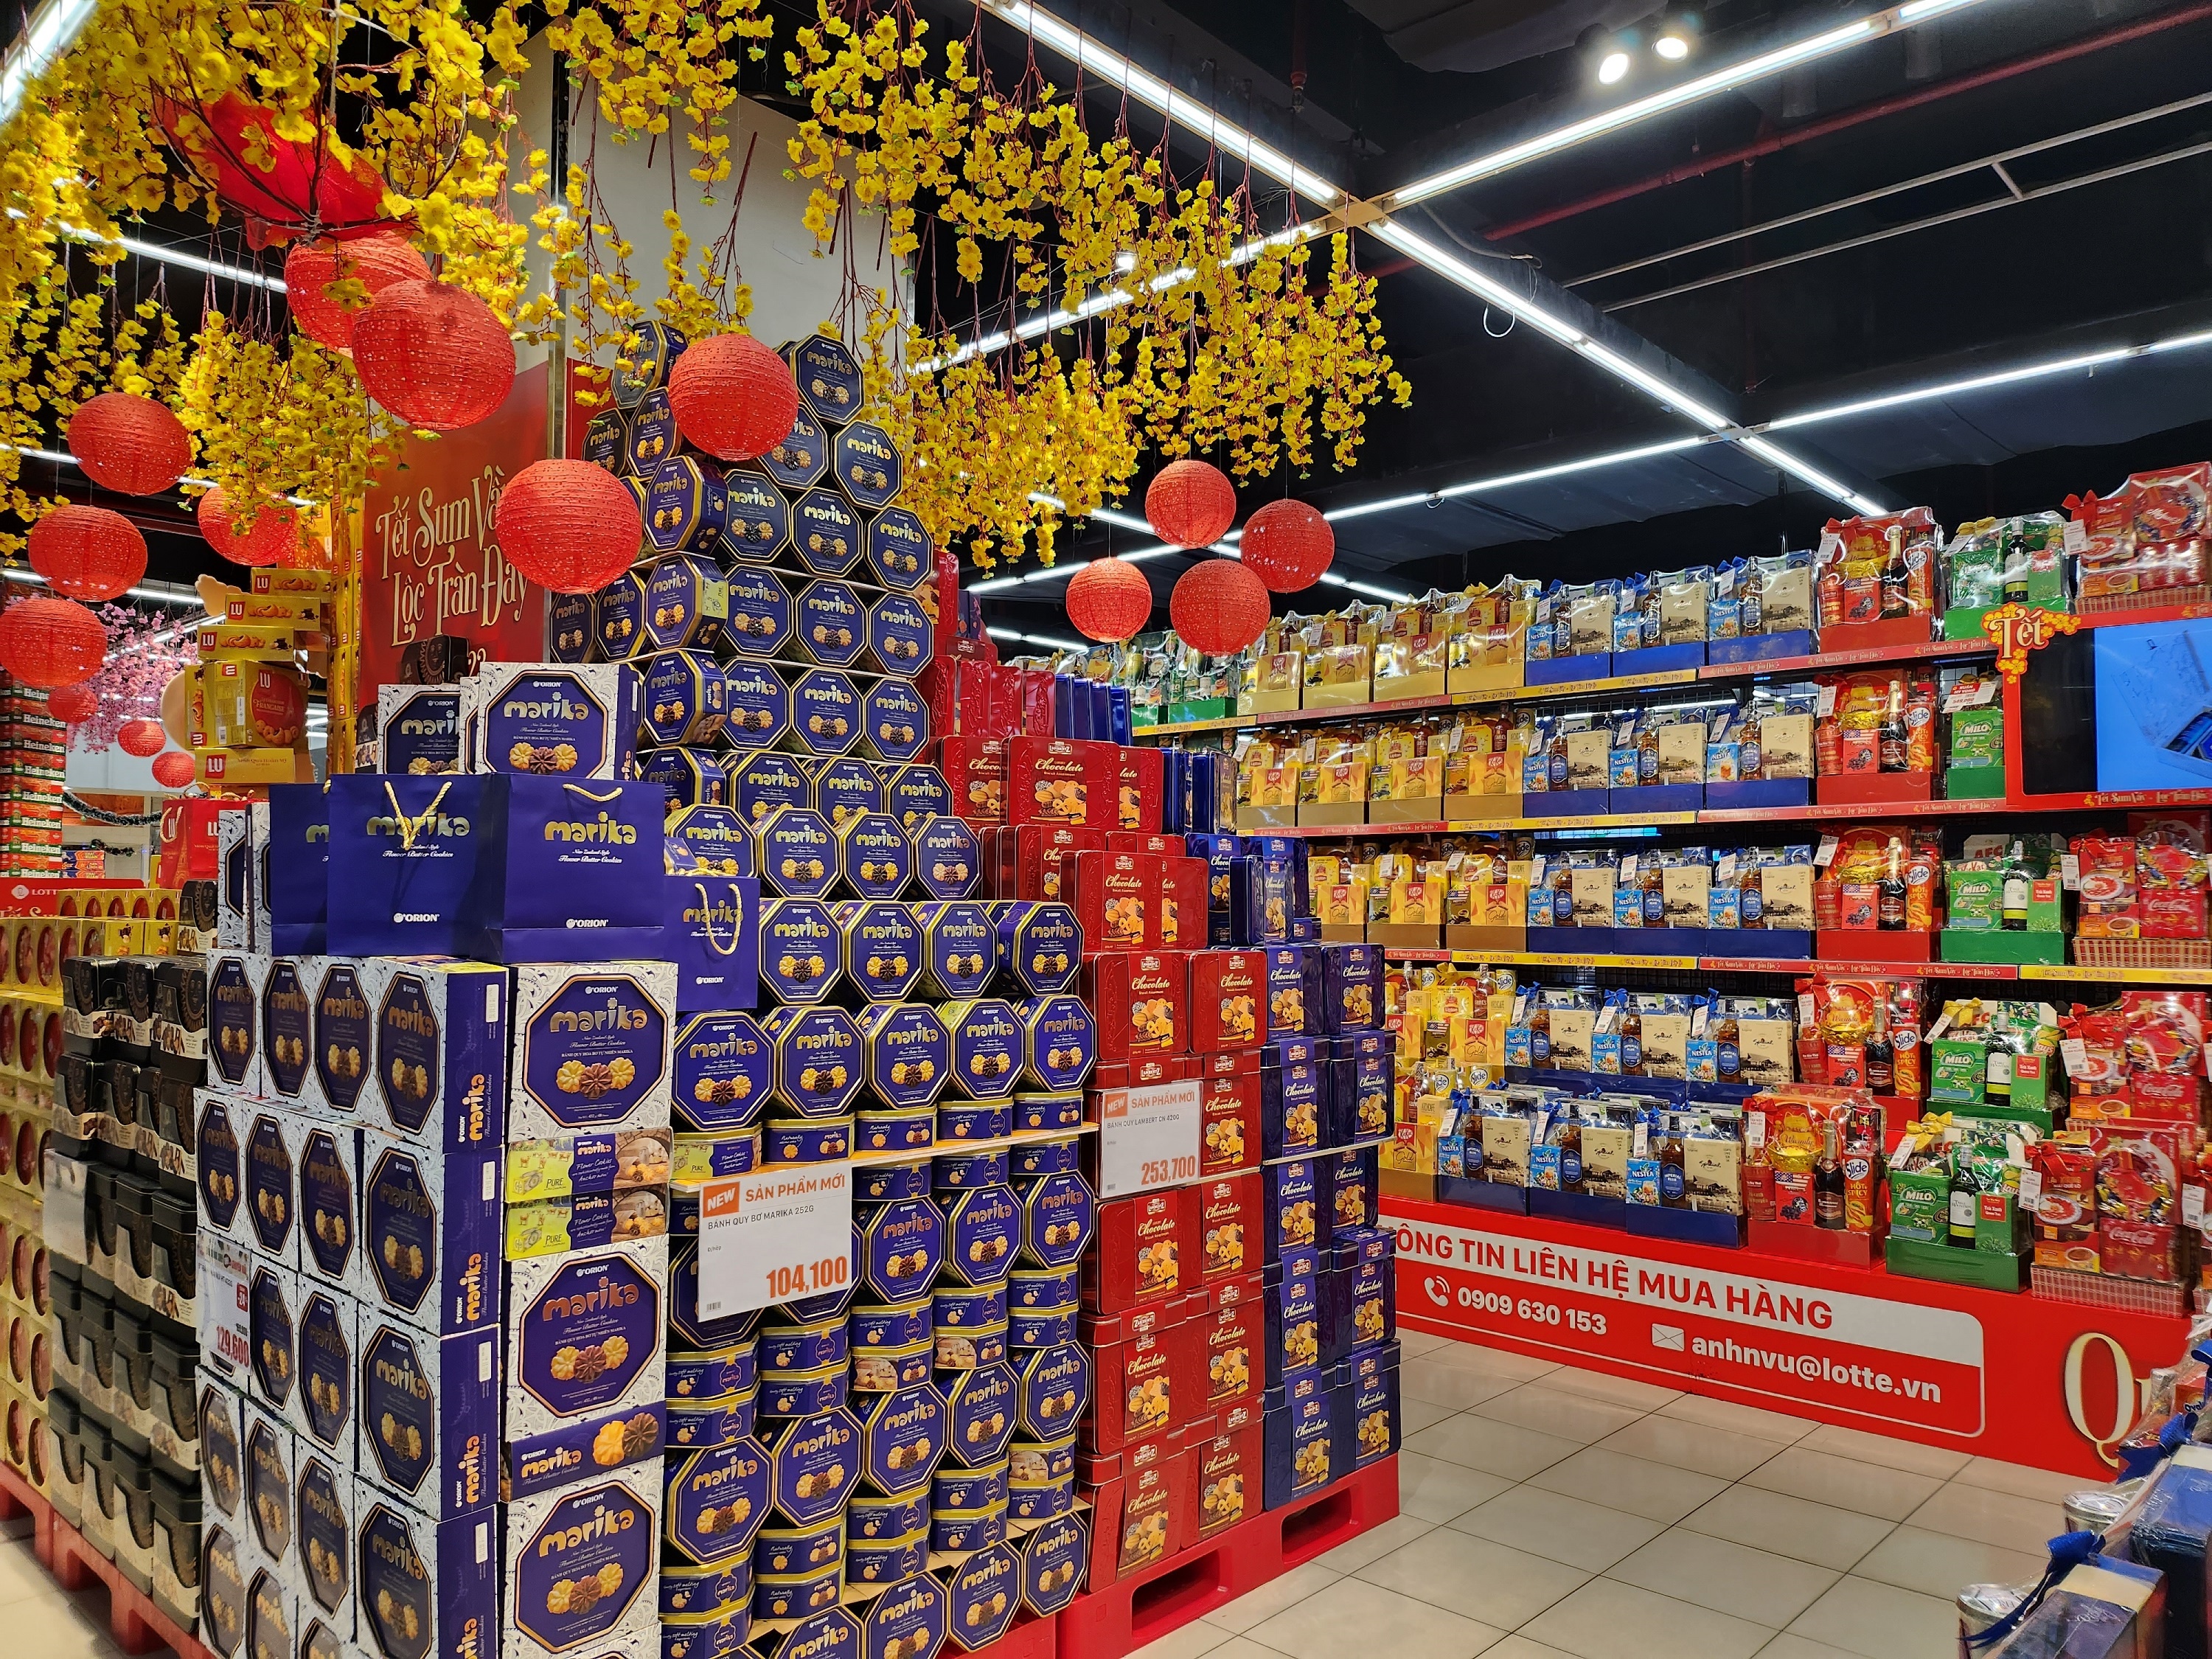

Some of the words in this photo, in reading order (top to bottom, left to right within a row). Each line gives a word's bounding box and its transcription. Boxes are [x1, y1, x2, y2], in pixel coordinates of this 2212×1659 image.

[807, 349, 853, 375] marika
[591, 423, 619, 446] marika
[846, 434, 891, 460] marika
[654, 476, 688, 495] marika
[376, 495, 410, 580] Tết
[413, 487, 470, 567] Sum
[257, 577, 268, 588] LU
[392, 572, 425, 647] Lộc
[428, 545, 477, 636] Tràn
[730, 582, 780, 603] marika
[230, 605, 243, 615] LU
[202, 635, 215, 646] LU
[1989, 608, 2045, 658] Tết
[260, 672, 271, 688] LU
[504, 692, 589, 720] marika
[876, 694, 918, 712] marika
[23, 715, 66, 728] Heineken
[1964, 725, 1988, 734] MILO
[24, 740, 65, 753] Heineken
[208, 758, 222, 773] LU
[1035, 758, 1084, 773] Chocolate
[22, 792, 62, 803] Heineken
[2111, 793, 2131, 804] Sum
[22, 818, 61, 829] Heineken
[856, 830, 901, 847] marika
[928, 832, 970, 849] marika
[1908, 867, 1929, 884] Slide
[1964, 885, 1988, 894] MILO
[406, 914, 439, 922] ORION
[577, 919, 608, 928] ORION
[1032, 920, 1075, 938] marika
[1220, 973, 1253, 988] Chocolate
[1270, 967, 1301, 981] Chocolate
[1497, 975, 1513, 989] Slide
[324, 987, 365, 1020] marika
[550, 997, 648, 1032] marika
[1044, 1012, 1085, 1032] marika
[1896, 1034, 1915, 1048] Slide
[1467, 1046, 1484, 1056] Gold
[1945, 1056, 1969, 1064] MILO
[1359, 1075, 1385, 1089] Chocolate
[1107, 1097, 1126, 1113] NEW
[1132, 1093, 1151, 1107] SẢN
[1152, 1092, 1178, 1106] PHẨM
[1178, 1090, 1195, 1103] MỚI
[1107, 1120, 1121, 1129] BÁNH
[1135, 1117, 1158, 1126] LAMBERT
[577, 1141, 611, 1155] marika
[1396, 1152, 1414, 1164] Gold
[1141, 1155, 1196, 1186] 253,700
[1632, 1170, 1655, 1178] NESTEA
[1846, 1162, 1868, 1177] Slide
[546, 1178, 563, 1188] PURE
[1280, 1182, 1312, 1197] Chocolate
[707, 1188, 736, 1211] NEW
[745, 1183, 774, 1202] SẢN
[778, 1175, 817, 1197] PHẨM
[821, 1173, 845, 1191] MỚI
[1905, 1191, 1930, 1201] MILO
[709, 1219, 731, 1230] BÁNH
[733, 1216, 749, 1225] QUY
[751, 1212, 762, 1222] BƠ
[764, 1208, 793, 1220] MARIKA
[796, 1205, 814, 1215] 252G
[967, 1200, 1012, 1225] marika
[883, 1211, 933, 1239] marika
[583, 1264, 609, 1275] ORION
[766, 1256, 848, 1299] 104,100
[1460, 1238, 1504, 1269] TIN
[1514, 1247, 1578, 1283] LIÊN
[1588, 1259, 1629, 1298] HỆ
[1639, 1270, 1717, 1310] MUA
[1726, 1284, 1832, 1329] HÀNG
[542, 1276, 639, 1323] marika
[1284, 1301, 1314, 1319] Chocolate
[1458, 1287, 1512, 1315] 0909
[1517, 1299, 1560, 1325] 630
[1565, 1309, 1607, 1335] 153
[1209, 1326, 1245, 1347] Chocolate
[217, 1325, 249, 1368] 129,600
[376, 1358, 428, 1400] marika
[1691, 1337, 1941, 1404] anhnvu@lotte.vn
[965, 1377, 1009, 1407] marika
[1357, 1392, 1386, 1410] Chocolate
[528, 1448, 547, 1459] ORION
[521, 1447, 582, 1478] marika
[1204, 1453, 1240, 1475] Chocolate
[580, 1492, 606, 1508] ORION
[539, 1504, 636, 1559] marika
[1036, 1523, 1078, 1558] marika
